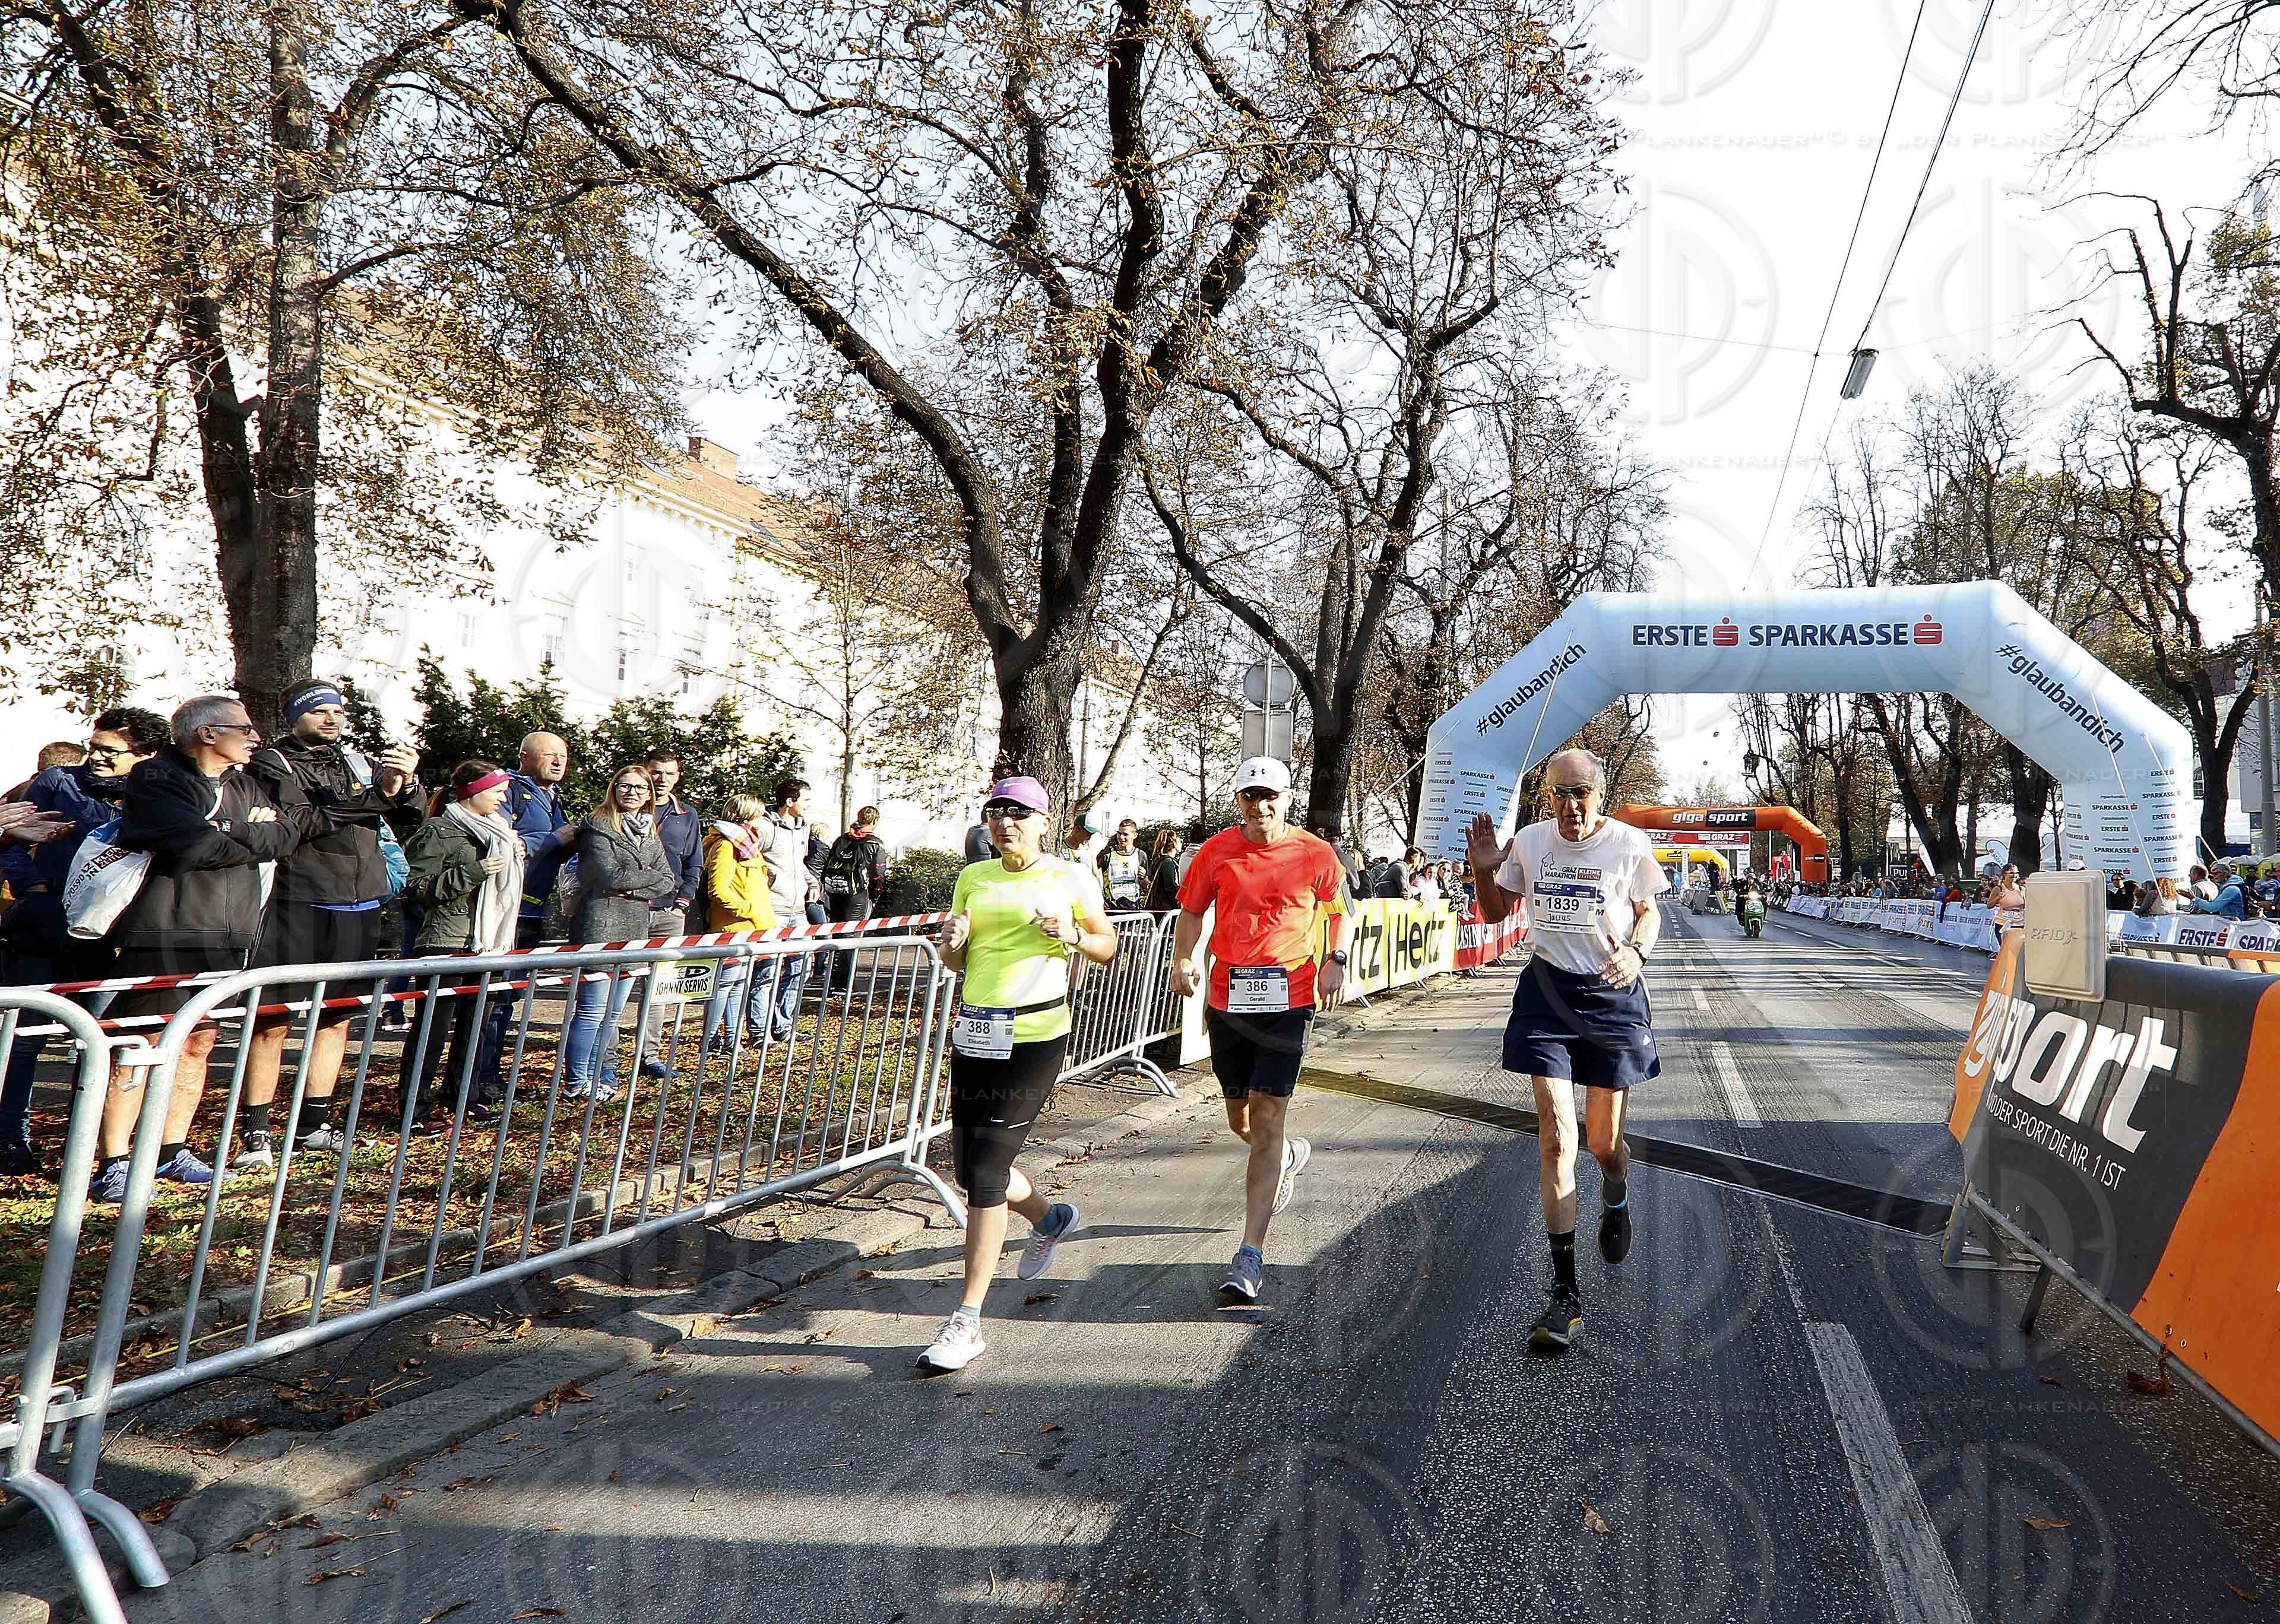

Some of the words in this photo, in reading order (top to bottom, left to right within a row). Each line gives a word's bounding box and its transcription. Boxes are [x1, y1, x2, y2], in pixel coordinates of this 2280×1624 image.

[1633, 624, 1707, 646] ERSTE
[1749, 623, 1908, 646] SPARKASSE
[1476, 642, 1587, 737] #glaubandich
[1995, 644, 2124, 753] #glaubandich
[1672, 811, 1704, 823] giga
[1708, 812, 1749, 824] sport
[1545, 870, 1576, 880] MARATHON
[1546, 896, 1579, 911] 1839
[1395, 911, 1445, 973] Hertz
[2178, 928, 2216, 947] ERSTE
[656, 981, 683, 995] JOHNNY
[684, 978, 708, 993] SERVIS
[1246, 981, 1268, 992] 386
[968, 1020, 990, 1035] 388
[2012, 1108, 2053, 1145] SPORT
[2048, 1130, 2072, 1158] DIE
[2067, 1140, 2089, 1172] NR.
[2092, 1154, 2102, 1178] 1
[2101, 1159, 2126, 1190] IST
